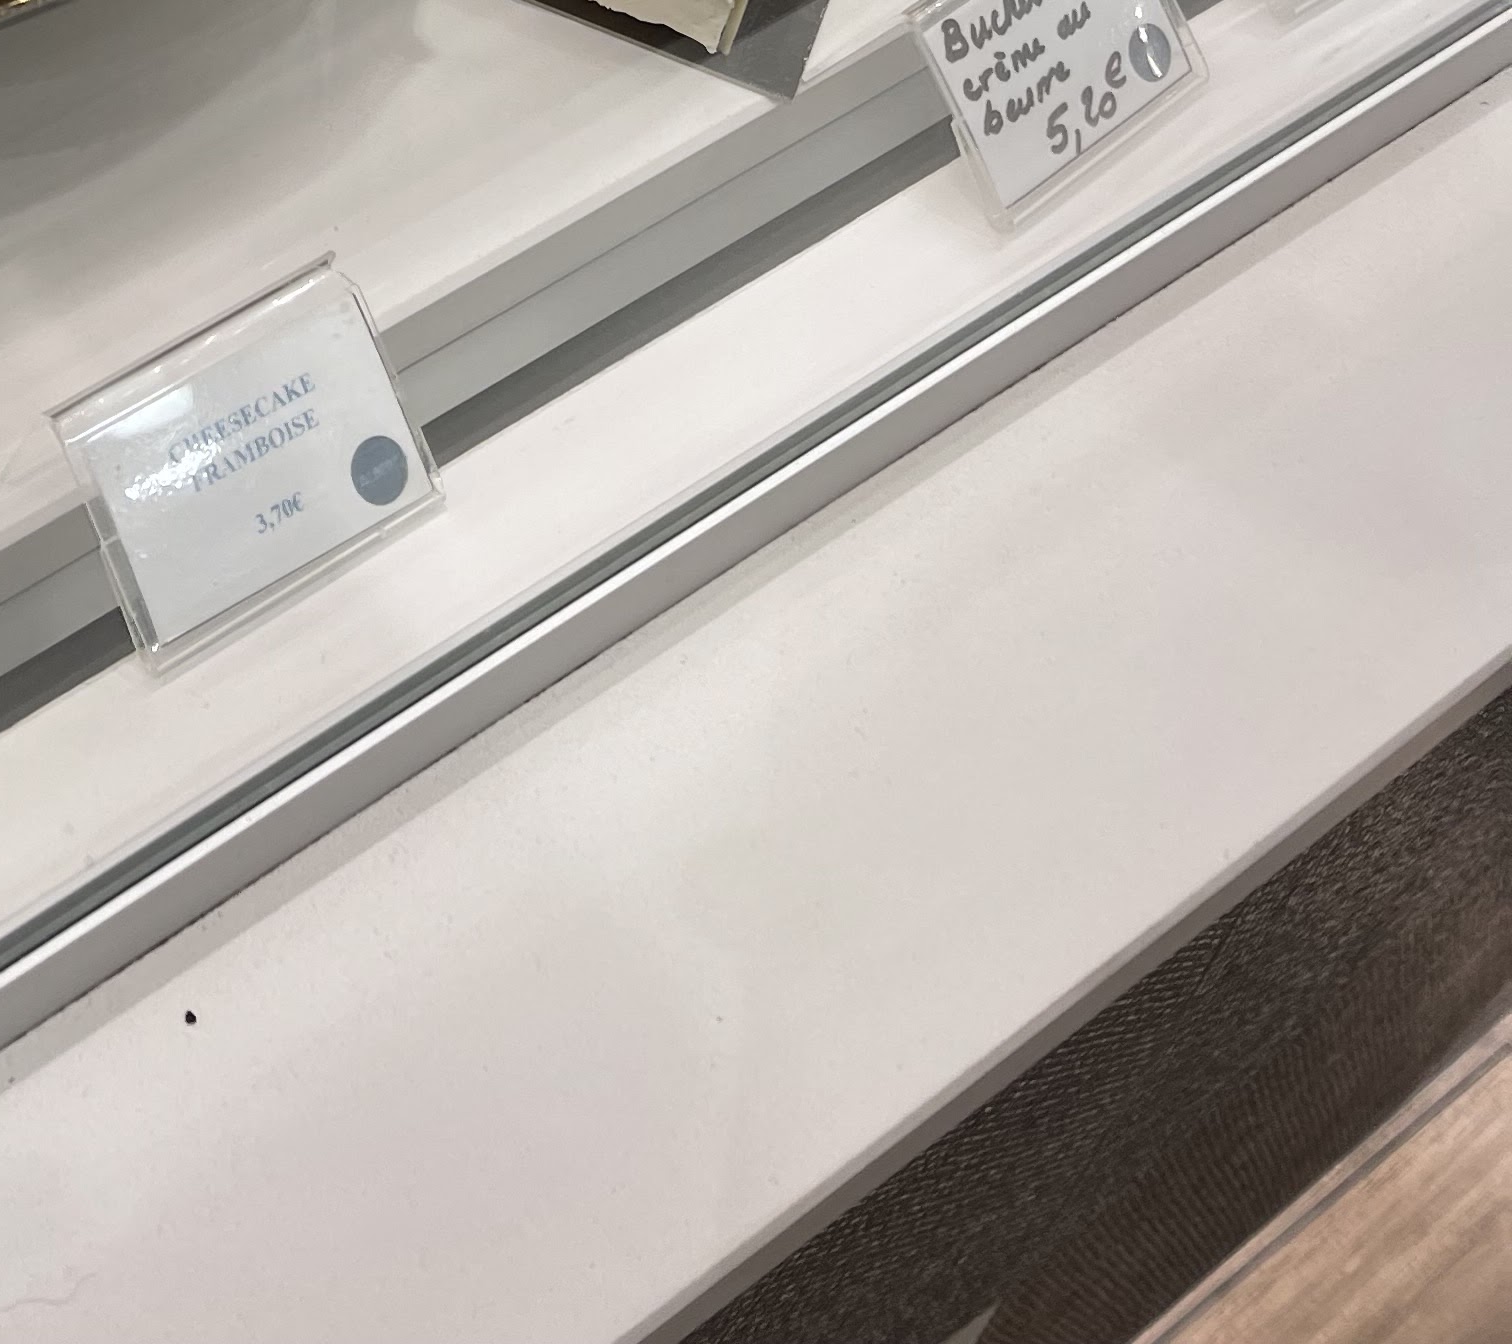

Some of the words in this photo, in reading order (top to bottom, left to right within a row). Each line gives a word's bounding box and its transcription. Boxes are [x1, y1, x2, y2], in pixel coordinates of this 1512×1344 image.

[1057, 1, 1091, 40] au
[168, 372, 316, 465] CHEESECAKE
[192, 408, 320, 493] FRAMBOISE
[255, 491, 306, 535] 3,70€
